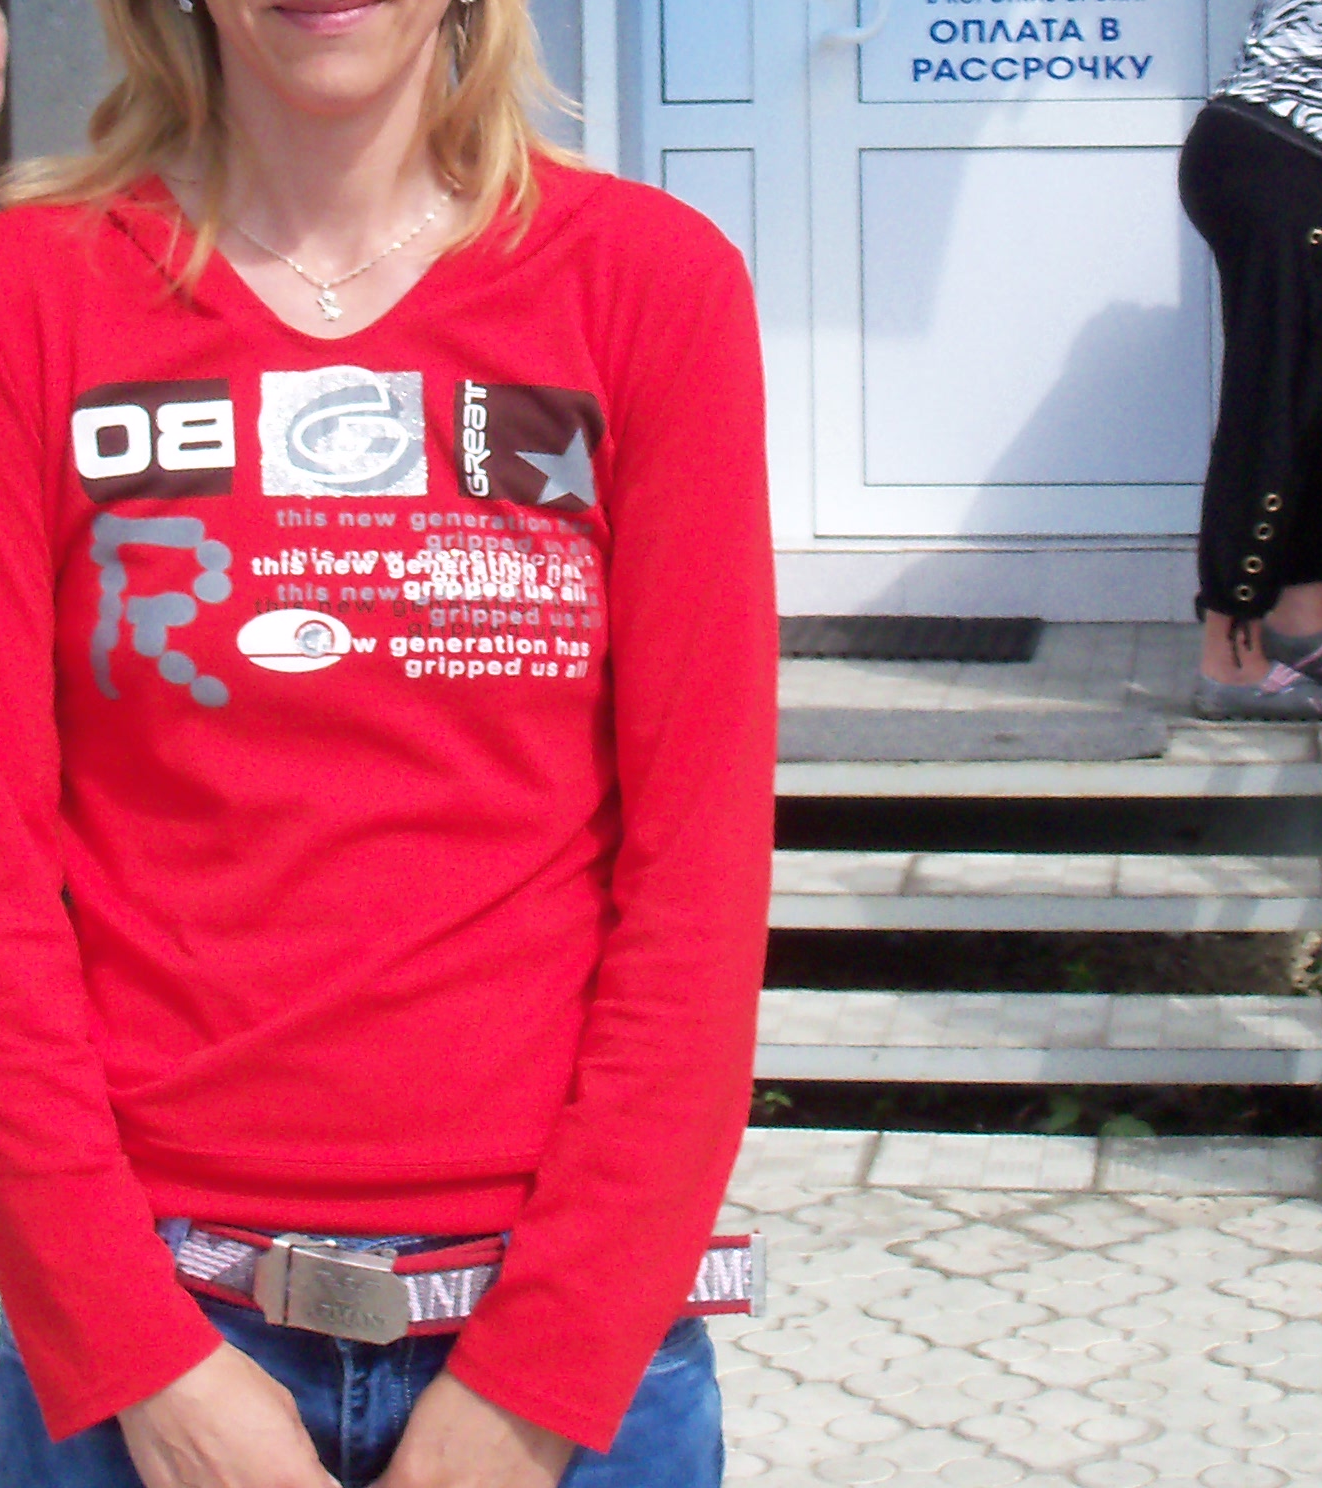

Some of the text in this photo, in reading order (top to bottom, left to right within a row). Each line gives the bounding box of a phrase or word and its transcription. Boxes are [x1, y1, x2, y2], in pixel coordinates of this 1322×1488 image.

[929, 17, 1121, 45] ОПЛАТА В
[912, 55, 1154, 83] РАССРОЧКУ
[277, 509, 327, 527] this
[338, 511, 397, 527] new
[251, 556, 306, 576] this
[315, 558, 377, 575] new
[389, 635, 548, 657] generation
[555, 635, 591, 657] has
[405, 656, 589, 678] gripped us all
